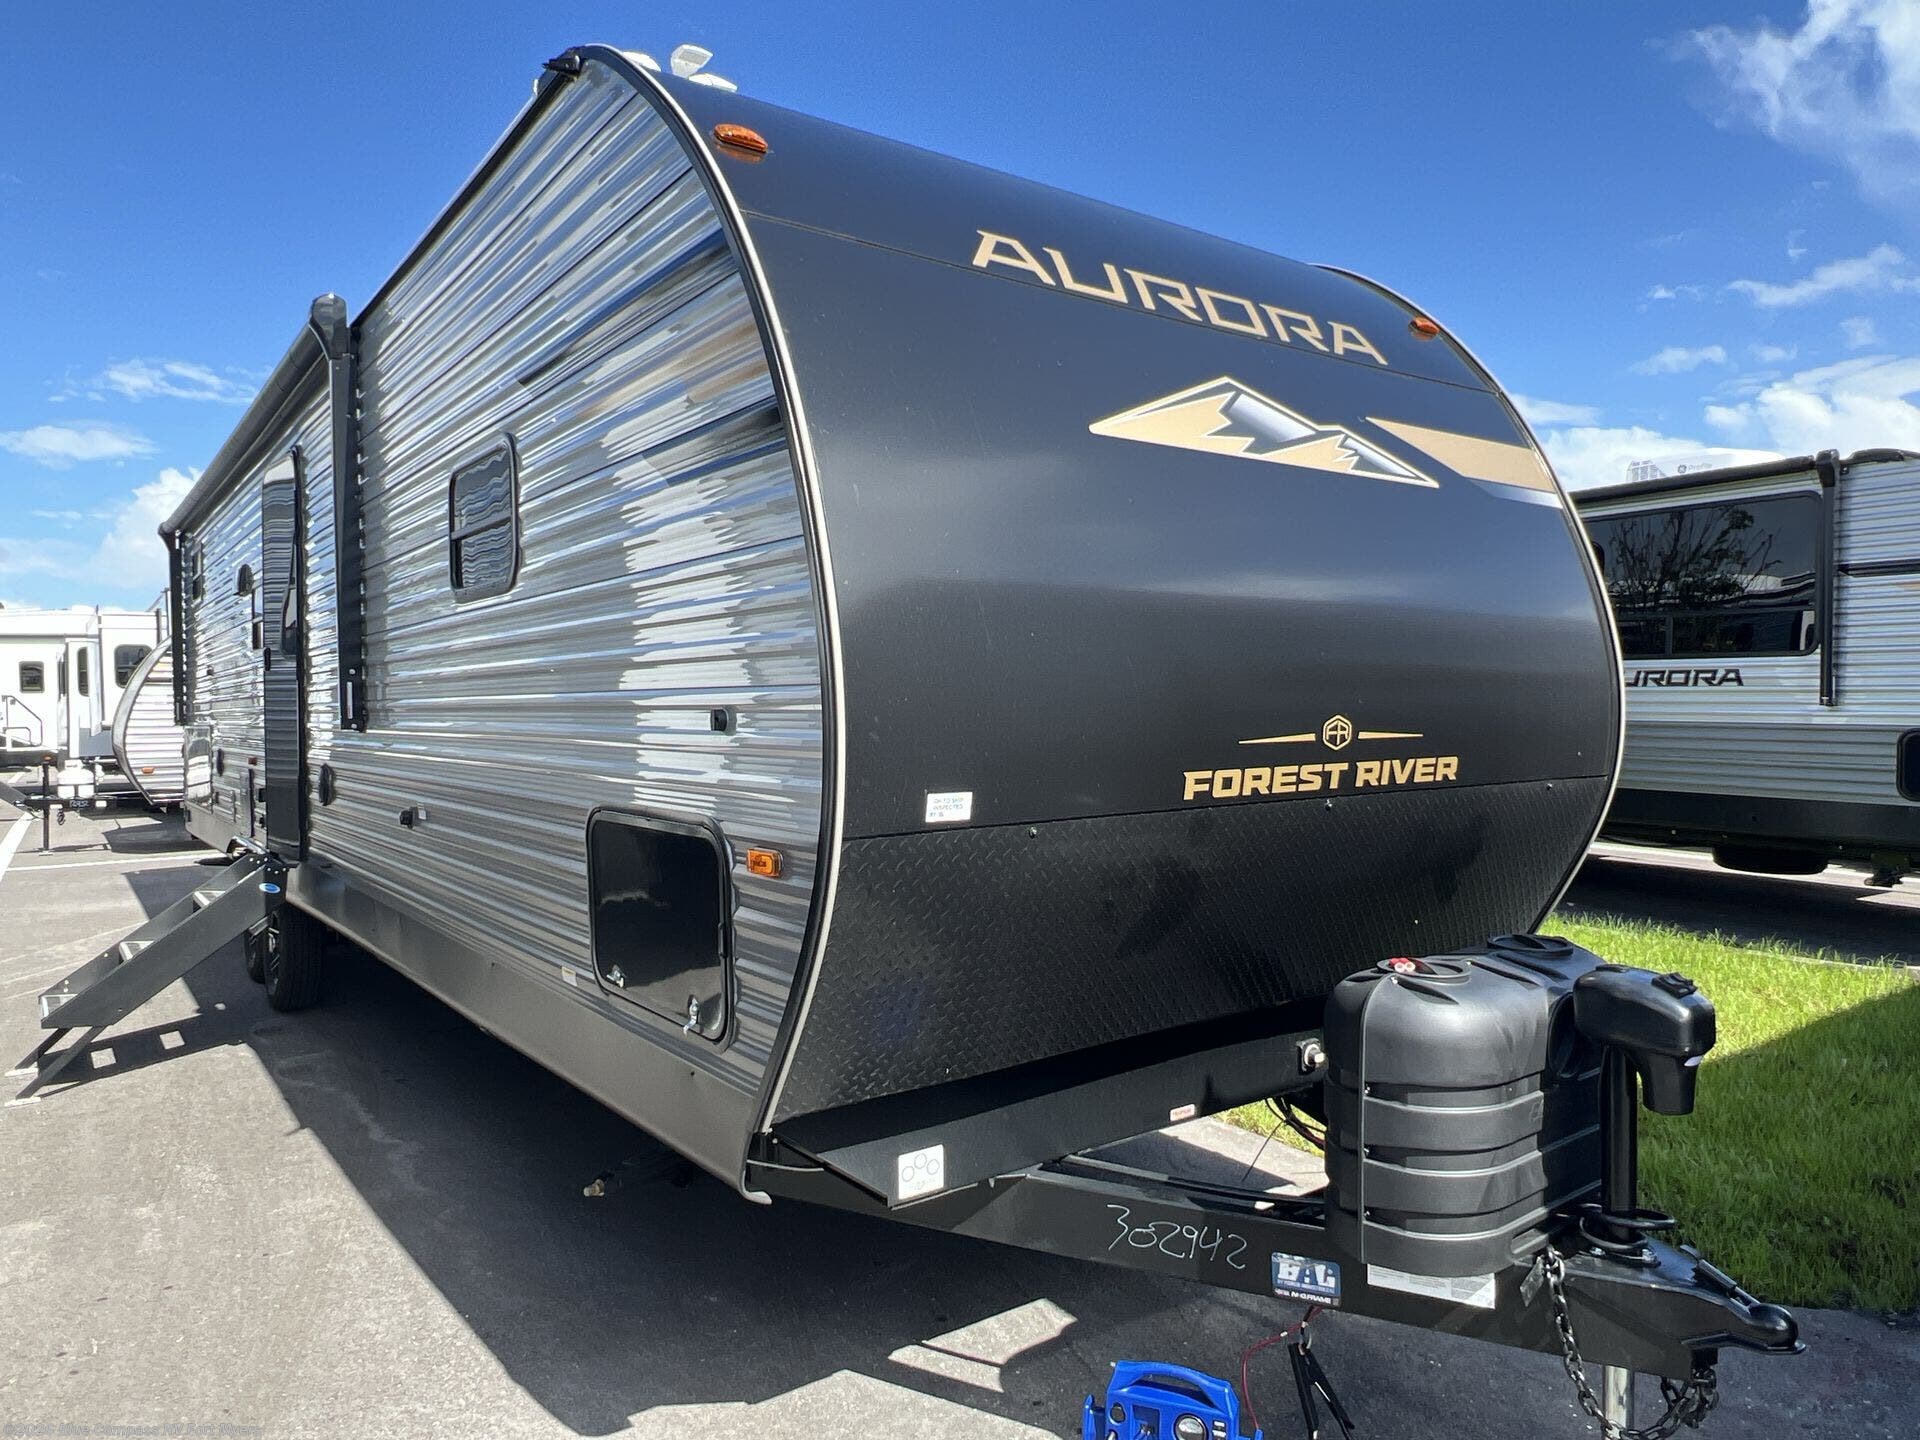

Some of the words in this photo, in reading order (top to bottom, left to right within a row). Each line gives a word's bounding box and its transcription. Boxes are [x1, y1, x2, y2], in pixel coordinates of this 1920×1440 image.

[973, 230, 1388, 365] AURORA
[1183, 763, 1349, 801] FOREST
[1355, 756, 1459, 788] RIVER
[1107, 1204, 1248, 1269] 302942
